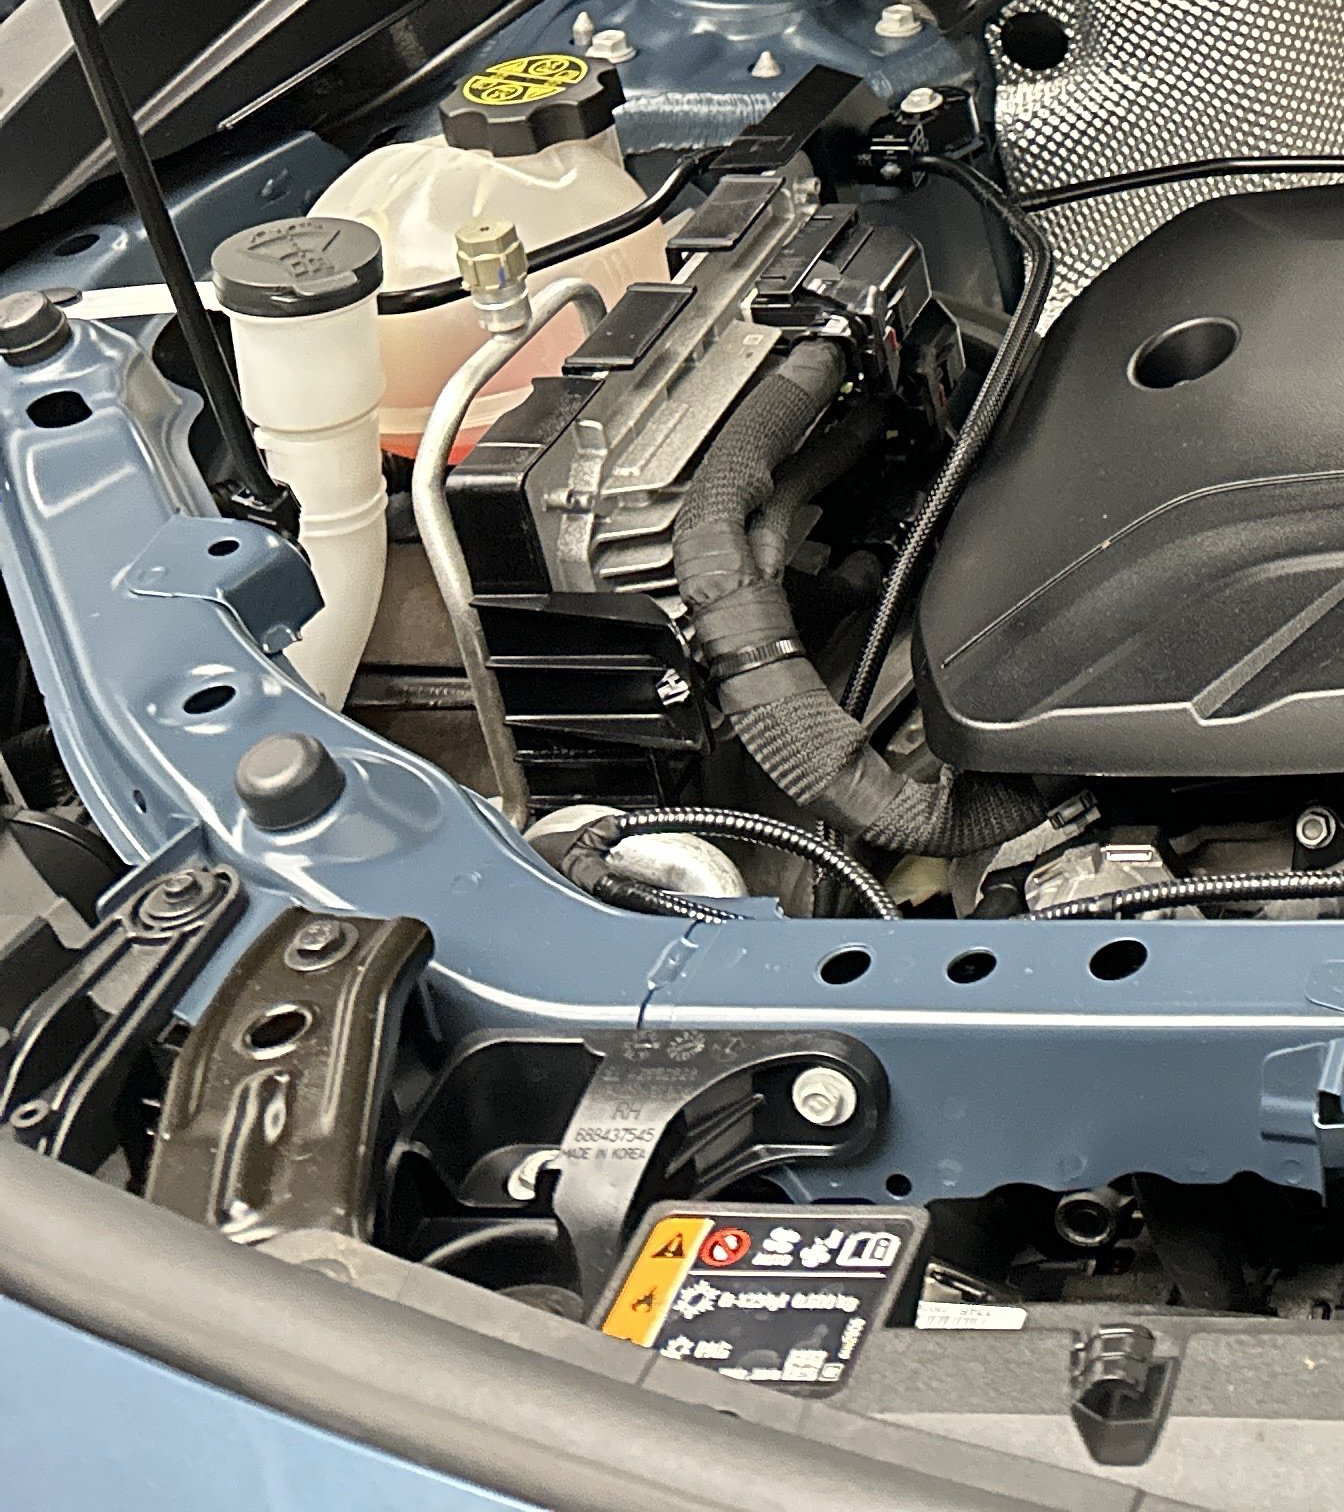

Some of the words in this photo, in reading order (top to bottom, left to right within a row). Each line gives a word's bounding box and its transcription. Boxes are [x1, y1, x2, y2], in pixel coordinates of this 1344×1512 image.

[611, 1102, 644, 1120] RH
[561, 1147, 591, 1160] MADE
[595, 1148, 609, 1160] IN
[612, 1148, 646, 1160] KOREA
